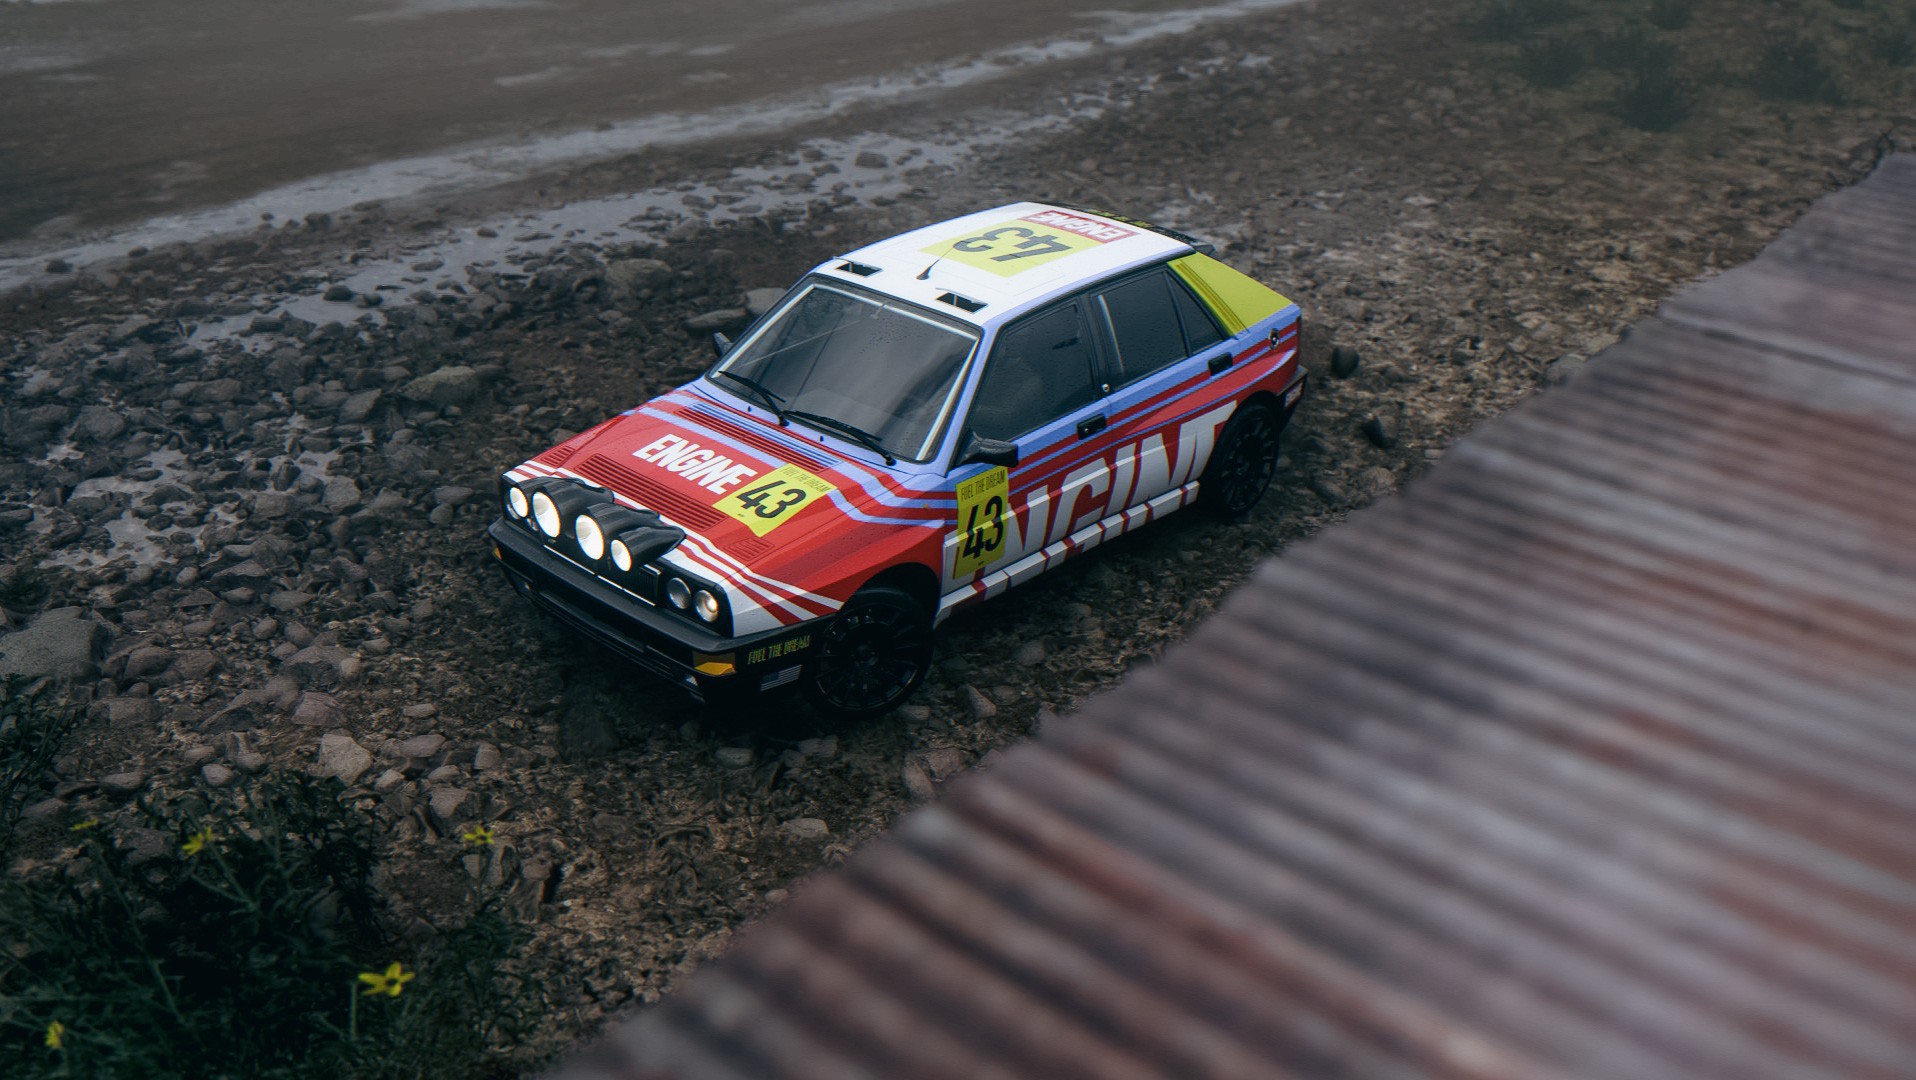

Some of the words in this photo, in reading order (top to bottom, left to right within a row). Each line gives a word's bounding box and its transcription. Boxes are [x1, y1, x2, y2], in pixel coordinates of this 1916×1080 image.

[953, 226, 1072, 263] 43
[1038, 212, 1122, 241] ENGINE
[632, 433, 758, 495] ENGINE
[736, 480, 807, 518] 43
[961, 483, 974, 502] FUEL
[975, 477, 986, 495] THE
[986, 469, 1006, 491] DREAM
[962, 495, 1004, 559] 43
[747, 647, 767, 665] FUEL
[768, 643, 783, 660] THE
